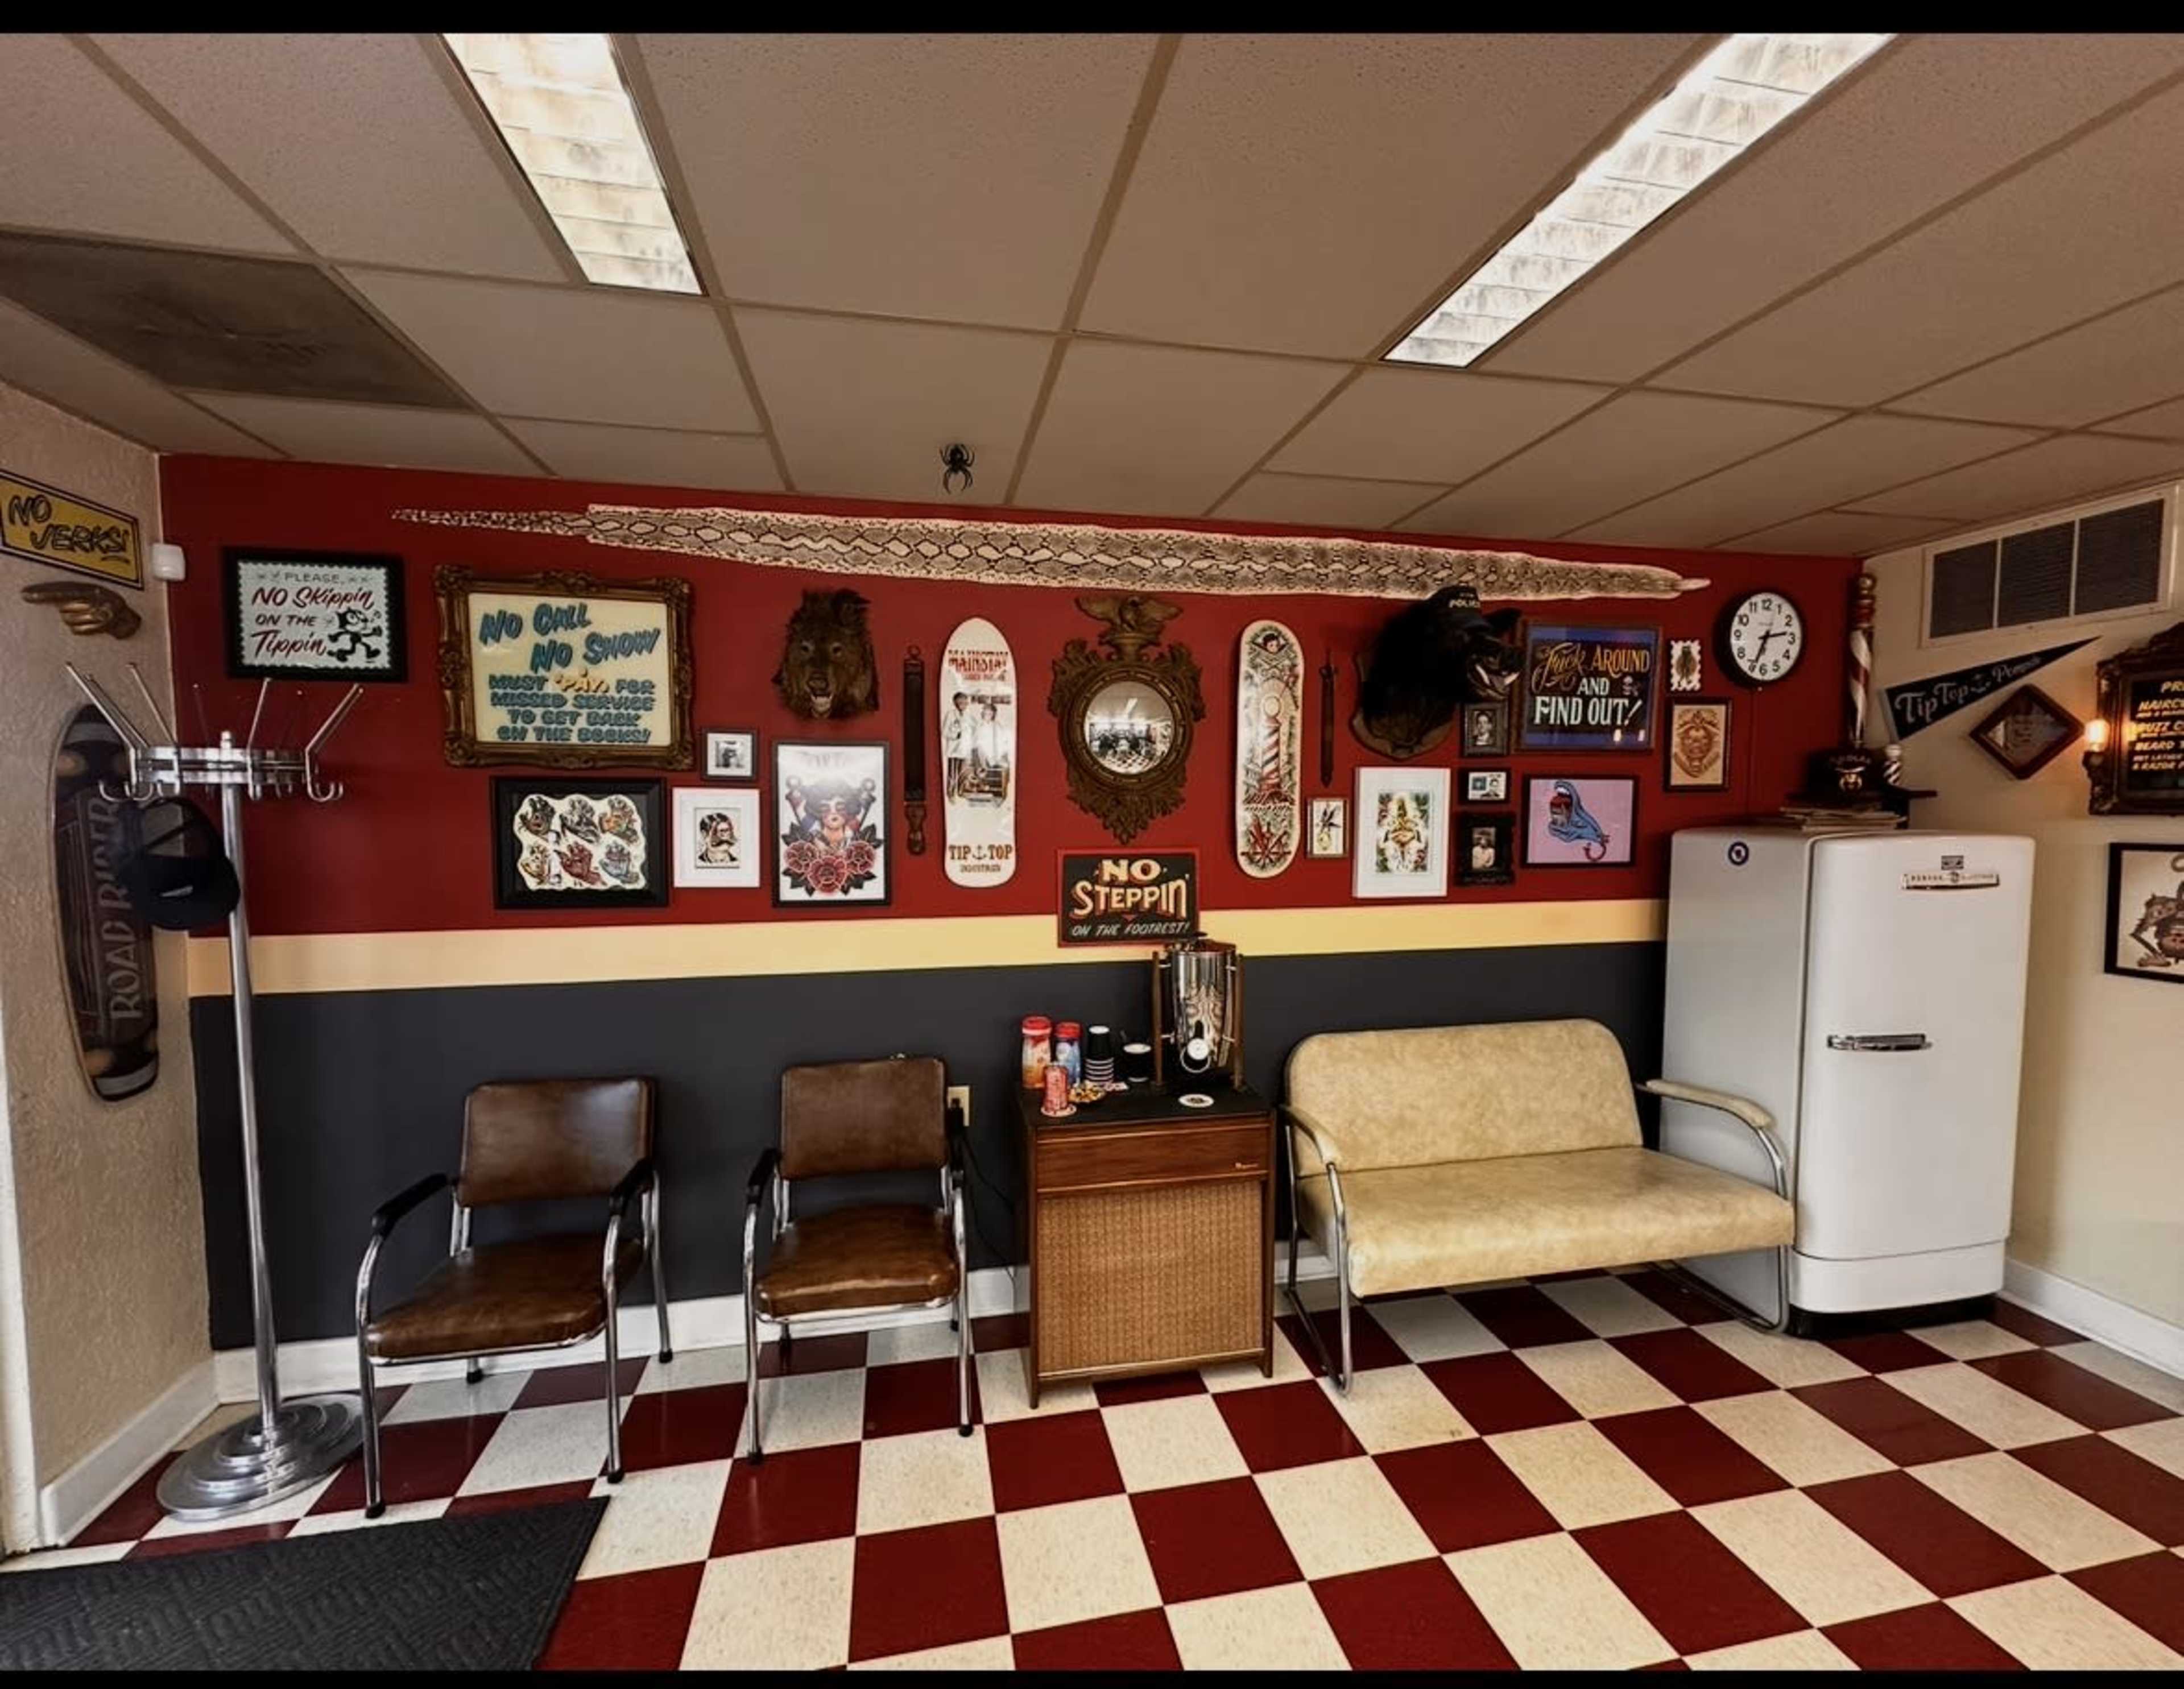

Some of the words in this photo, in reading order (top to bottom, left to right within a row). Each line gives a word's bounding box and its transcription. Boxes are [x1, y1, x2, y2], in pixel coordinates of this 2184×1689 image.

[9, 494, 52, 526] NO
[252, 587, 288, 607] NO
[1761, 598, 1772, 610] 12
[1749, 602, 1757, 613] 11
[1775, 604, 1781, 614] 1
[255, 614, 280, 626] ON
[287, 614, 318, 627] THE
[479, 609, 523, 645] NO
[1739, 614, 1749, 627] 10
[1785, 615, 1792, 627] 2
[1734, 630, 1742, 640] 9
[1788, 632, 1796, 645] 3
[530, 639, 573, 674] NO
[582, 628, 661, 665] SHOW
[1737, 647, 1745, 659] 8
[1782, 649, 1790, 660] 4
[1591, 645, 1650, 678] AROUND
[1759, 663, 1767, 676] 6
[1772, 660, 1781, 672] 5
[489, 674, 548, 690] MUST
[614, 679, 656, 694] FOR
[1576, 677, 1611, 696] AND
[490, 692, 567, 707] MISSED
[572, 693, 656, 711] SERVICE
[1895, 692, 1938, 723] Tip
[1933, 682, 1968, 704] Top
[507, 709, 536, 725] TO
[541, 710, 582, 726] GET
[586, 711, 641, 727] BACK
[1534, 696, 1584, 726] FIND
[1587, 697, 1643, 726] OUT!
[497, 726, 528, 741] ON
[533, 727, 573, 741] THE
[577, 727, 652, 744] BOOKS!
[2135, 740, 2175, 751] BEARD
[949, 844, 971, 860] TIP
[987, 844, 1012, 860] TOP
[1098, 858, 1162, 883] NO
[1072, 924, 1092, 937] ON
[1096, 924, 1120, 936] THE
[101, 920, 144, 1021] ROAD
